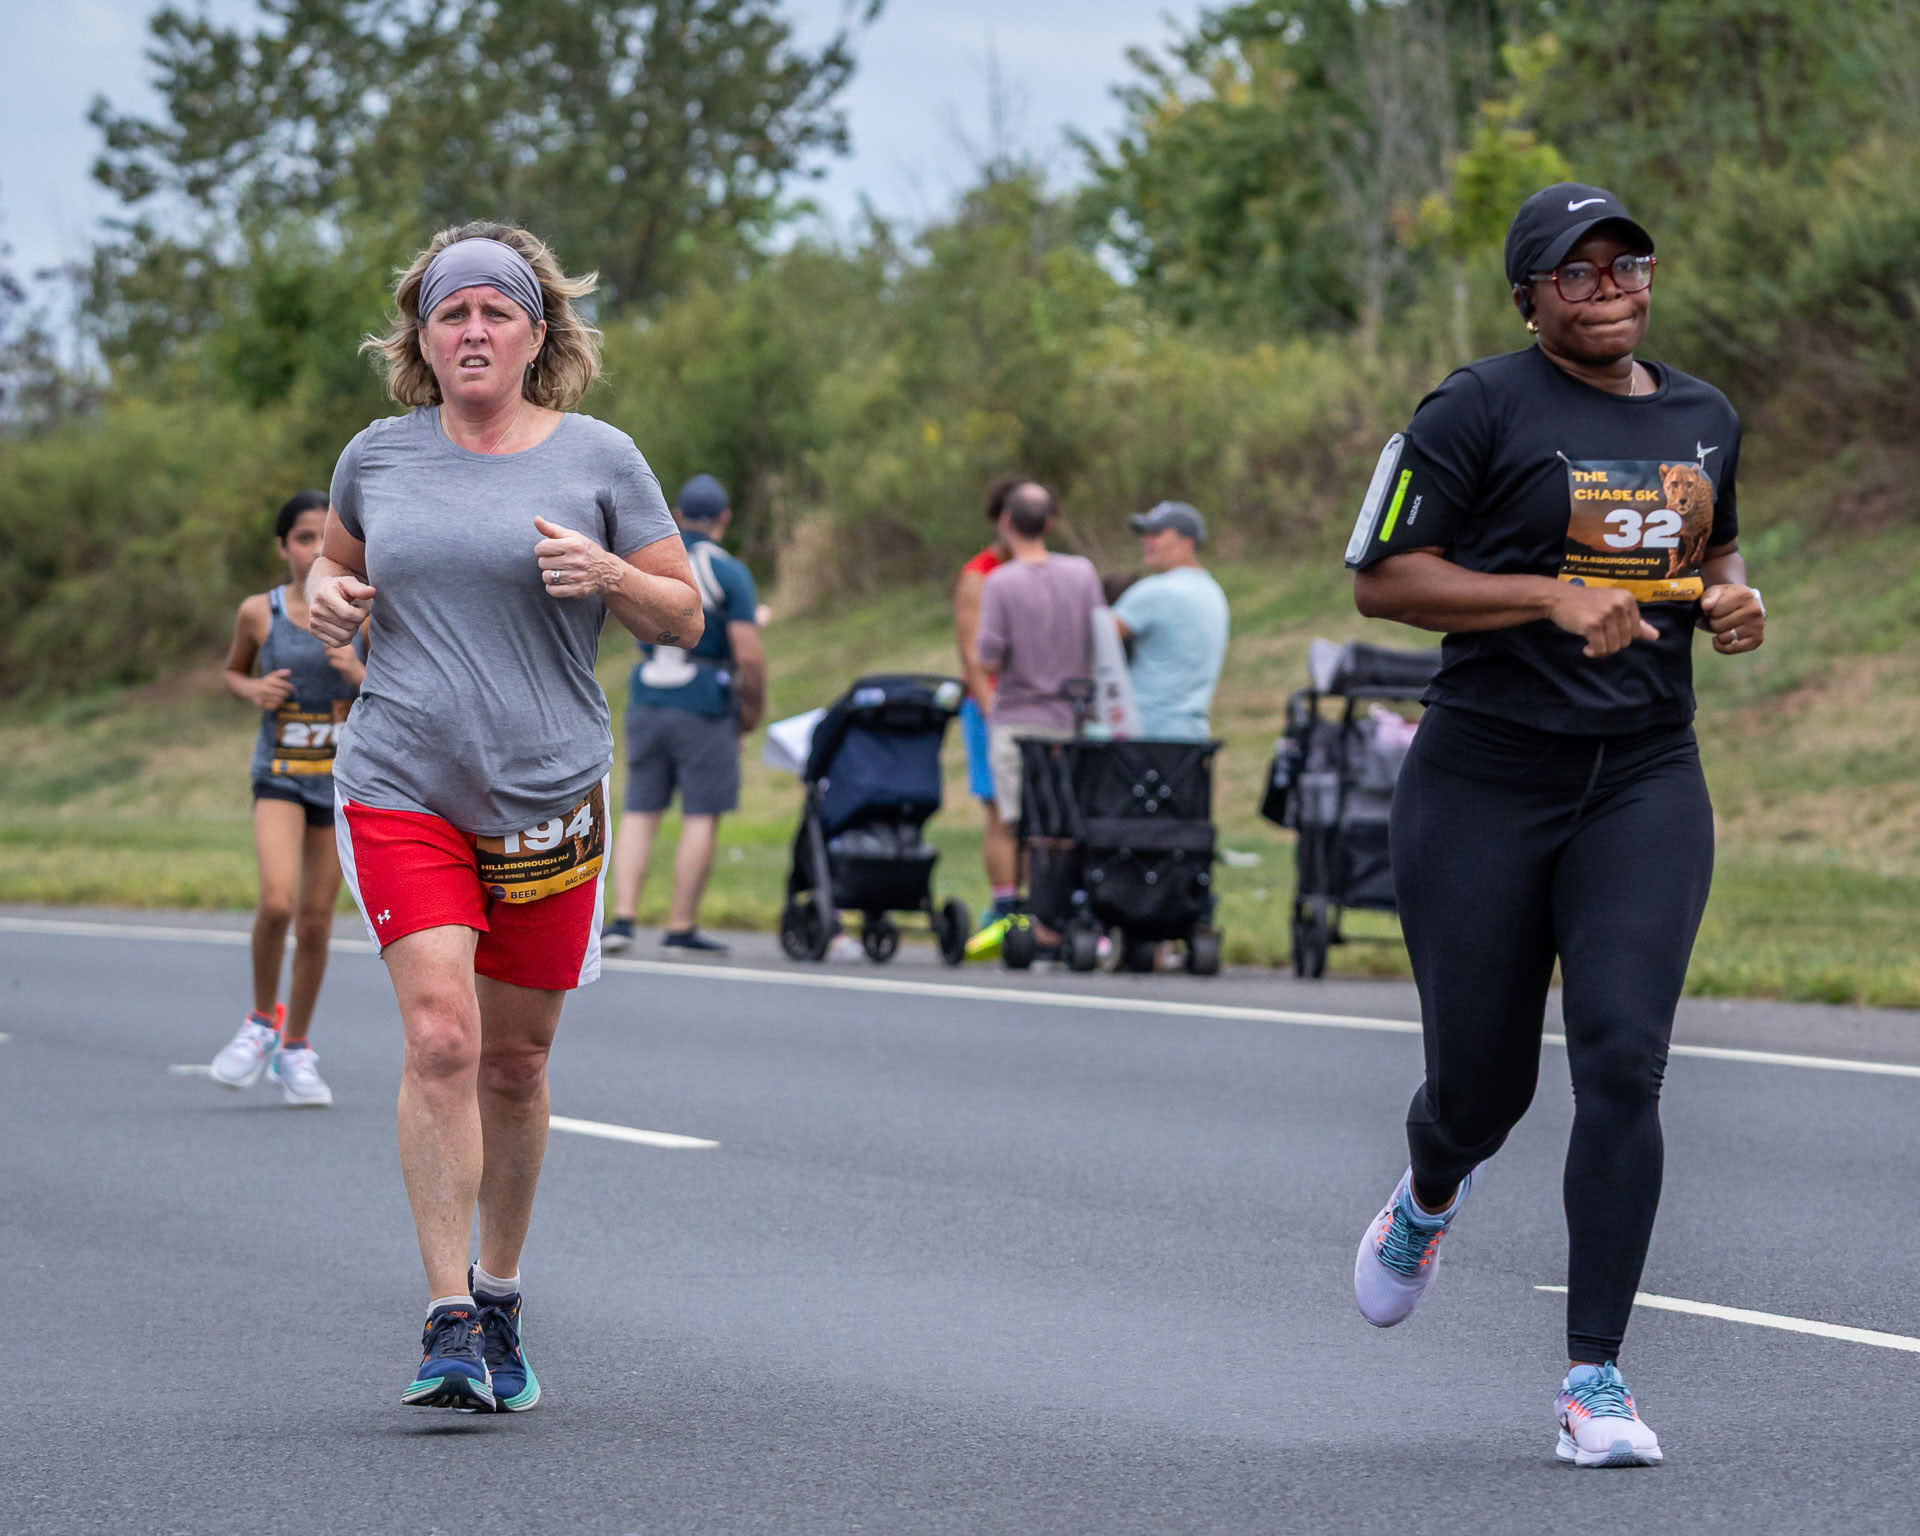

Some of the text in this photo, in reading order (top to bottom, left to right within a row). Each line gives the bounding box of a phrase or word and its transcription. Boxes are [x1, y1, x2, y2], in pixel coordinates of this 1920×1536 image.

[1571, 471, 1609, 483] THE
[1573, 488, 1633, 501] CHASE
[1603, 508, 1682, 548] 32
[481, 857, 557, 870] HILLSBOROUGH
[558, 852, 569, 863] NJ
[565, 875, 578, 887] BAG
[510, 889, 537, 899] BEER
